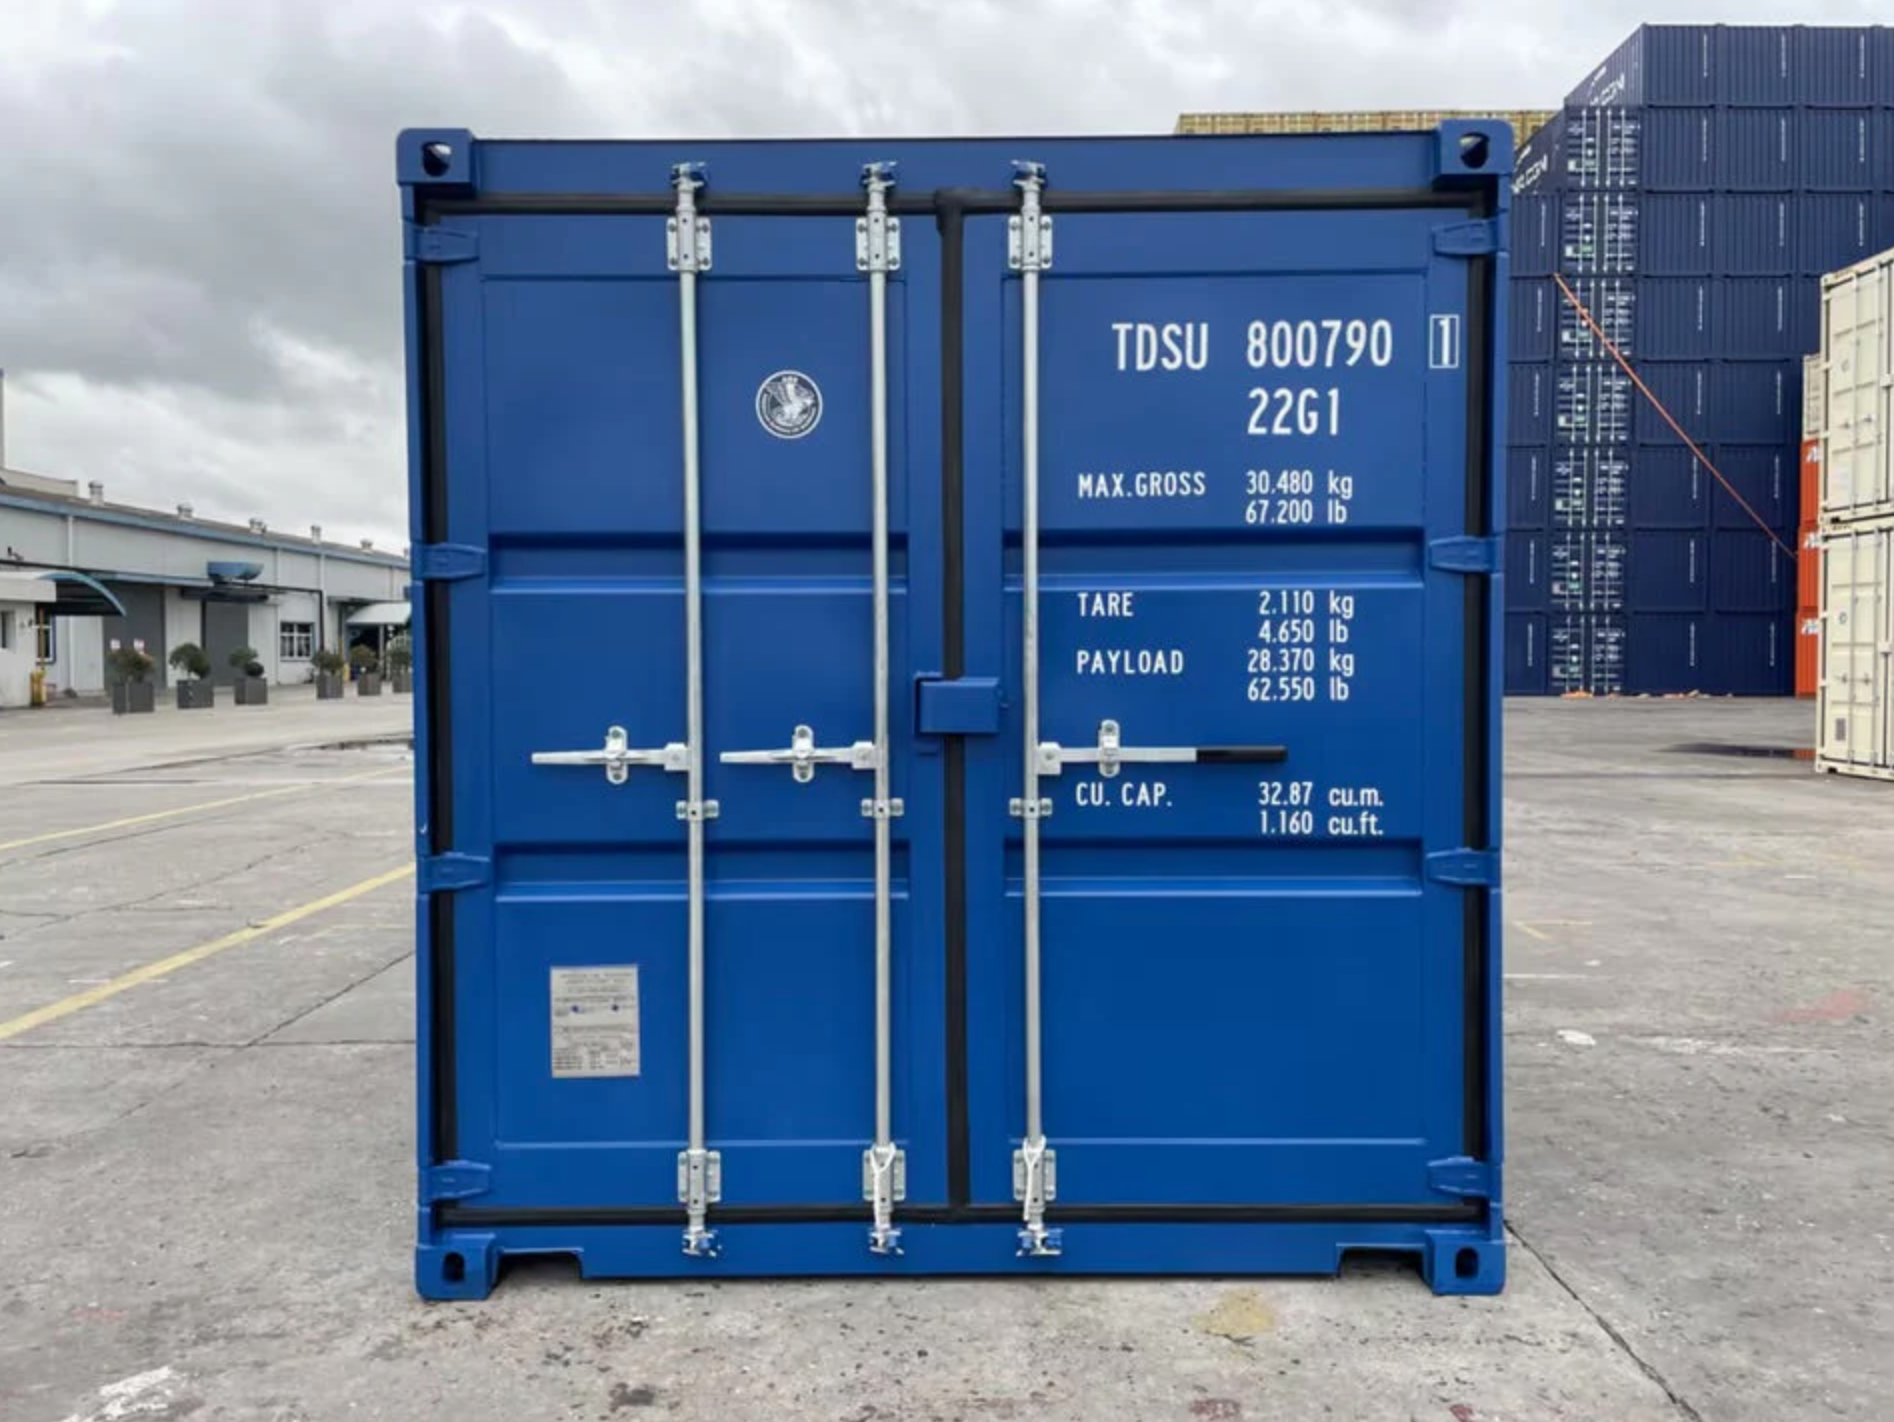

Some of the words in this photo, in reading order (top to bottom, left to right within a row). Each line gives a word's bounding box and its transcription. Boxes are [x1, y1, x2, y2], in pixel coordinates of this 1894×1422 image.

[1112, 323, 1208, 370] TDSU
[1247, 320, 1392, 367] 800790
[1435, 316, 1454, 366] 1
[1247, 388, 1338, 435] 22G1
[1078, 472, 1205, 497] MAX.GROSS
[1246, 470, 1313, 494] 30.480
[1328, 470, 1353, 499] kg
[1245, 500, 1312, 523] 67.200
[1328, 500, 1347, 523] lb
[1078, 592, 1133, 617] TARE
[1259, 590, 1314, 614] 2.110
[1329, 590, 1354, 619] kg
[1259, 619, 1314, 643] 4.650
[1329, 619, 1348, 642] lb
[1077, 650, 1183, 674] PAYLOAD
[1247, 648, 1314, 672] 28.370
[1329, 648, 1354, 677] kg
[1247, 677, 1314, 700] 62.550
[1329, 677, 1348, 700] lb
[1075, 782, 1110, 806] CU.
[1121, 782, 1172, 806] CAP.
[1259, 782, 1312, 805] 32.87
[1328, 787, 1384, 807] cu.m.
[1260, 811, 1312, 834] 1.160
[1328, 811, 1384, 835] cu.ft.
